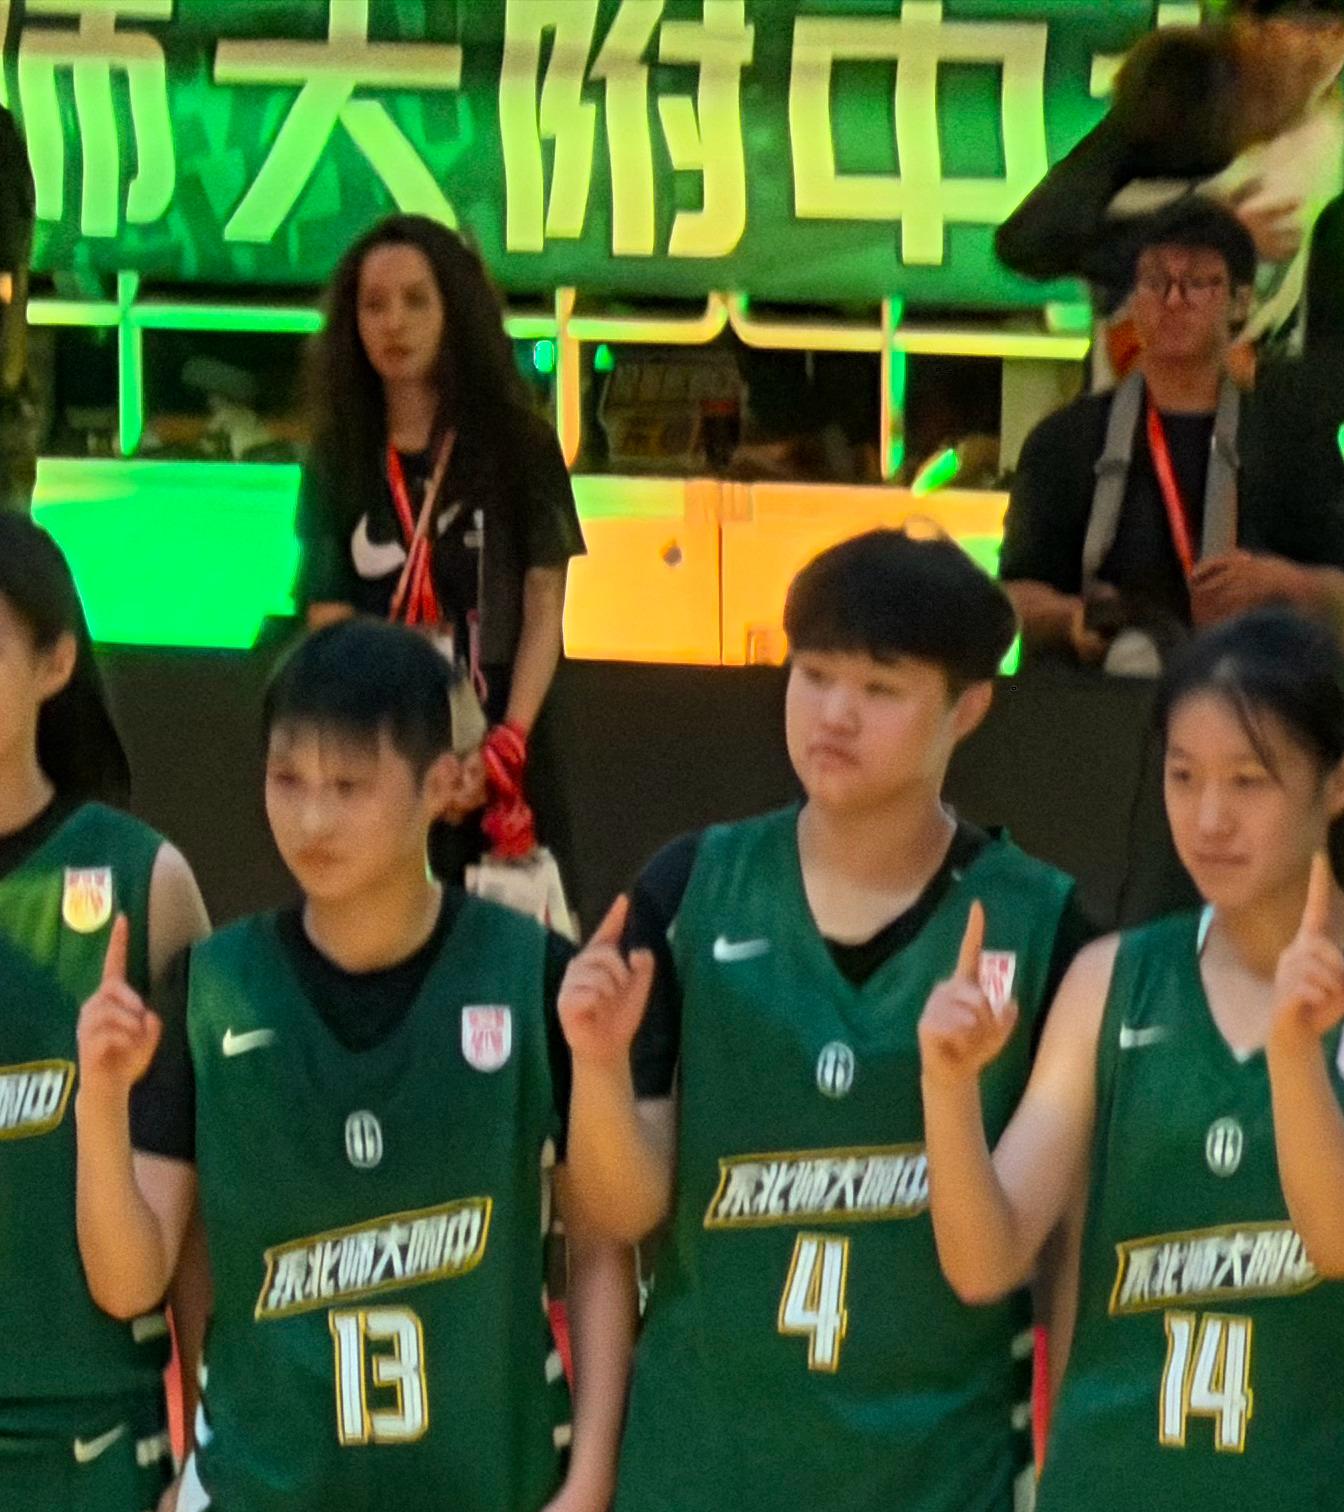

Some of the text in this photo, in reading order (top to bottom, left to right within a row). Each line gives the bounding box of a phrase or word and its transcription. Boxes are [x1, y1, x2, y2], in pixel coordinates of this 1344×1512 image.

[778, 1231, 850, 1373] 4
[329, 1305, 429, 1446] 13
[1159, 1309, 1254, 1454] 14
